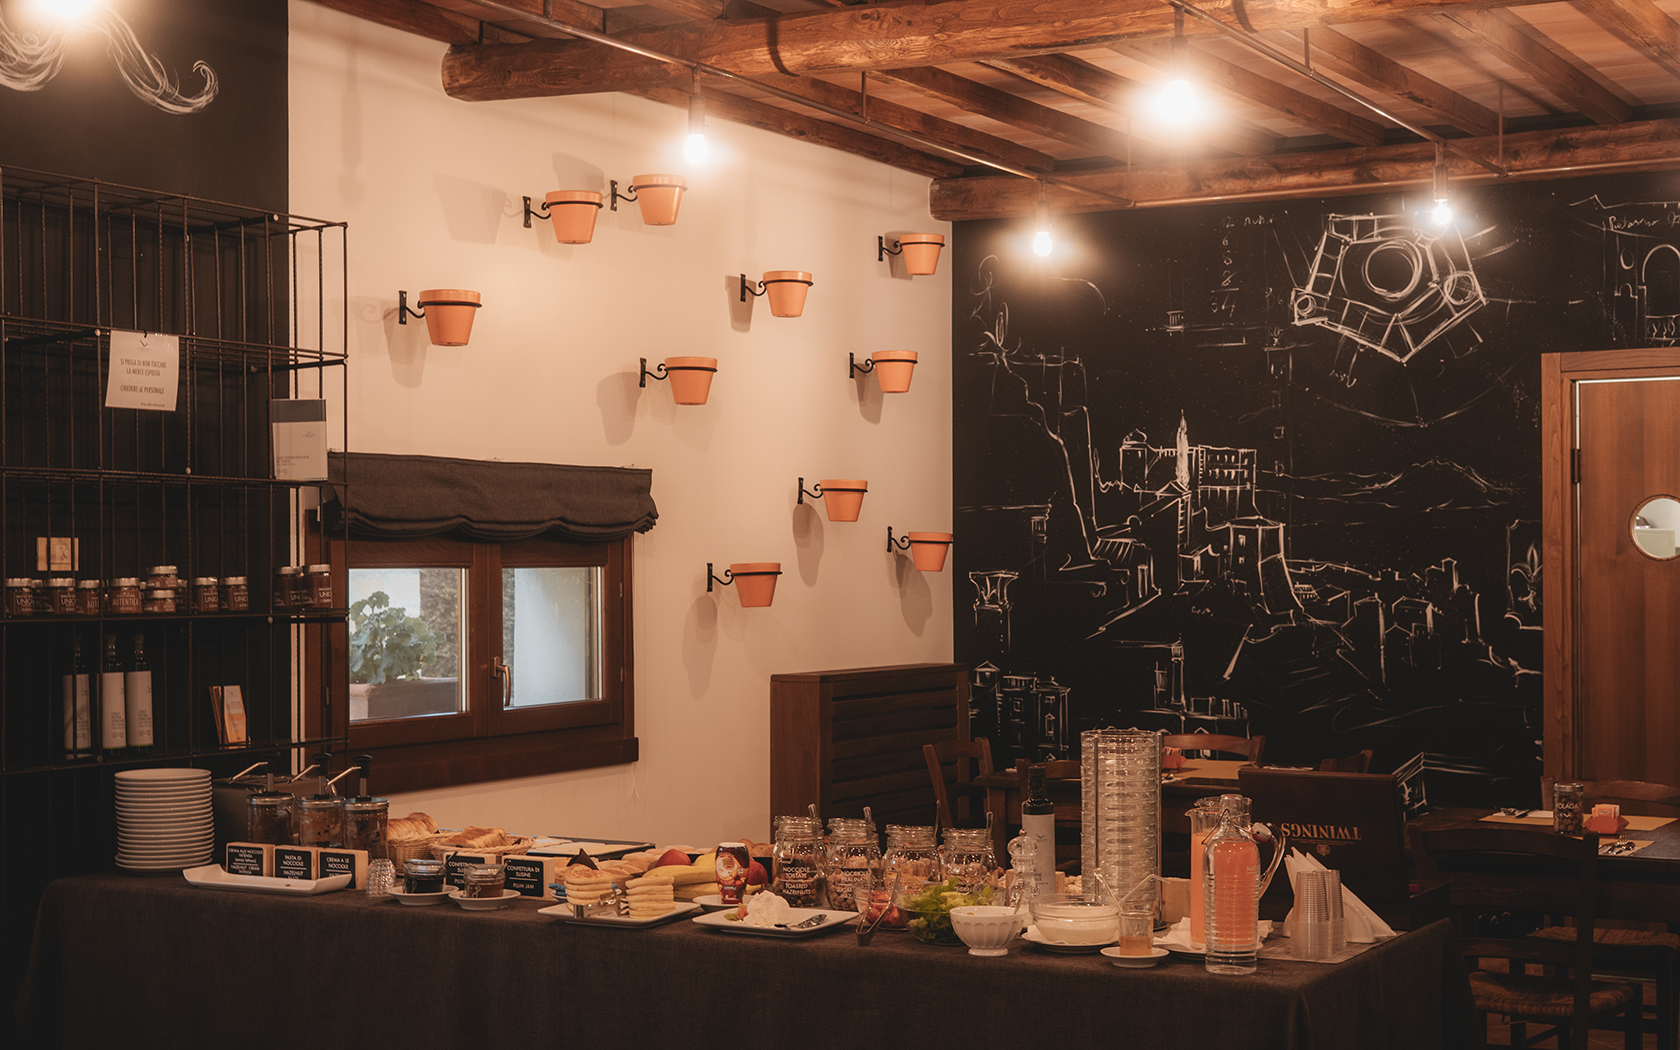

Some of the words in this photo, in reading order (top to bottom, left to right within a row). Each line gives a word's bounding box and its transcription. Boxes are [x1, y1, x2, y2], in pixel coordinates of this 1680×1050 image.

[120, 385, 138, 393] CHIEDERE
[112, 597, 139, 606] AUTENTICA
[1281, 823, 1362, 841] TWININGS
